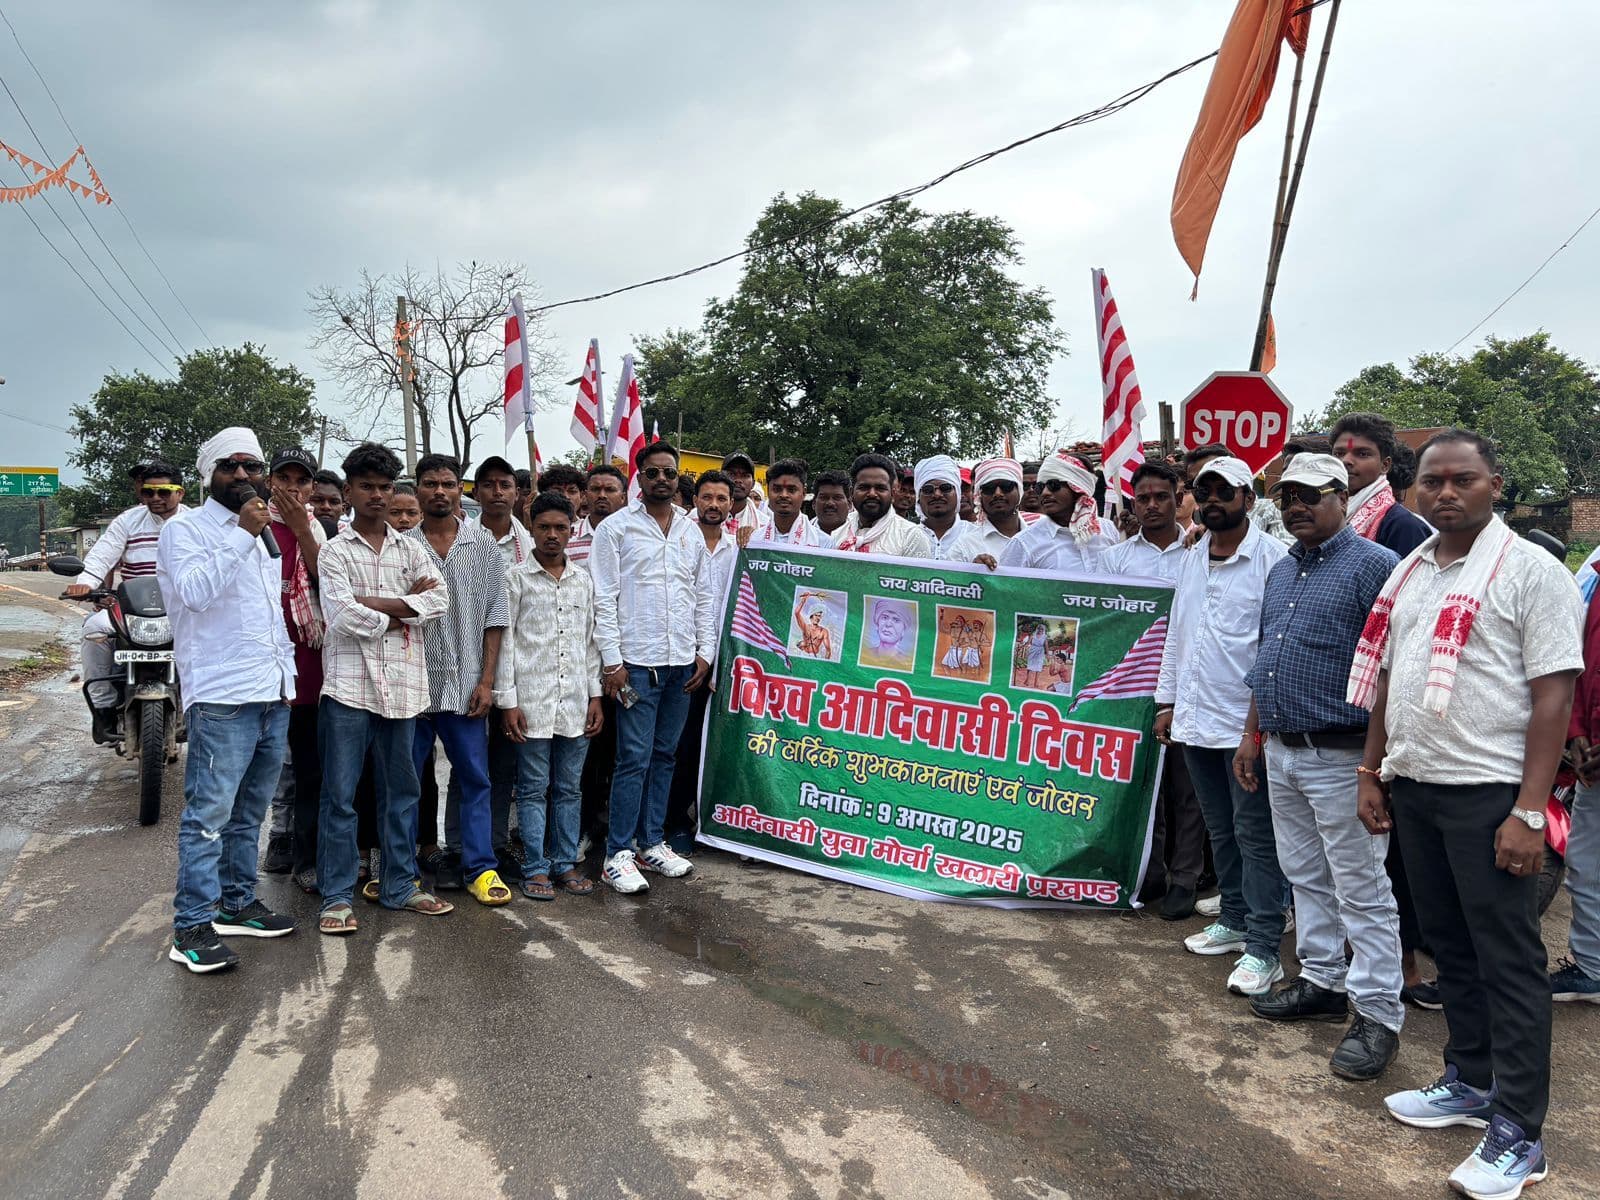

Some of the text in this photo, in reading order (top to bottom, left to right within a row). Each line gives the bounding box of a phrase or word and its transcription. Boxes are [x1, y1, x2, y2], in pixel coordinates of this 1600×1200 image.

[1192, 409, 1282, 448] STOP
[282, 449, 311, 463] BOSS
[748, 559, 815, 578] जय जोहार
[879, 576, 984, 600] जय आदिवासी
[1062, 593, 1159, 613] जय जोहार
[729, 656, 1143, 783] विश्व आदिवासी दिवस
[747, 729, 1099, 820] की हार्दिक शुभकामनाएं एवं जोहार
[800, 783, 862, 817] दिनांक
[877, 803, 892, 824] 9
[895, 806, 959, 838] अगस्त
[960, 820, 1024, 852] 2025
[712, 804, 1121, 904] आदिवासी युवा मोर्चा खलारी प्रखण्ड
